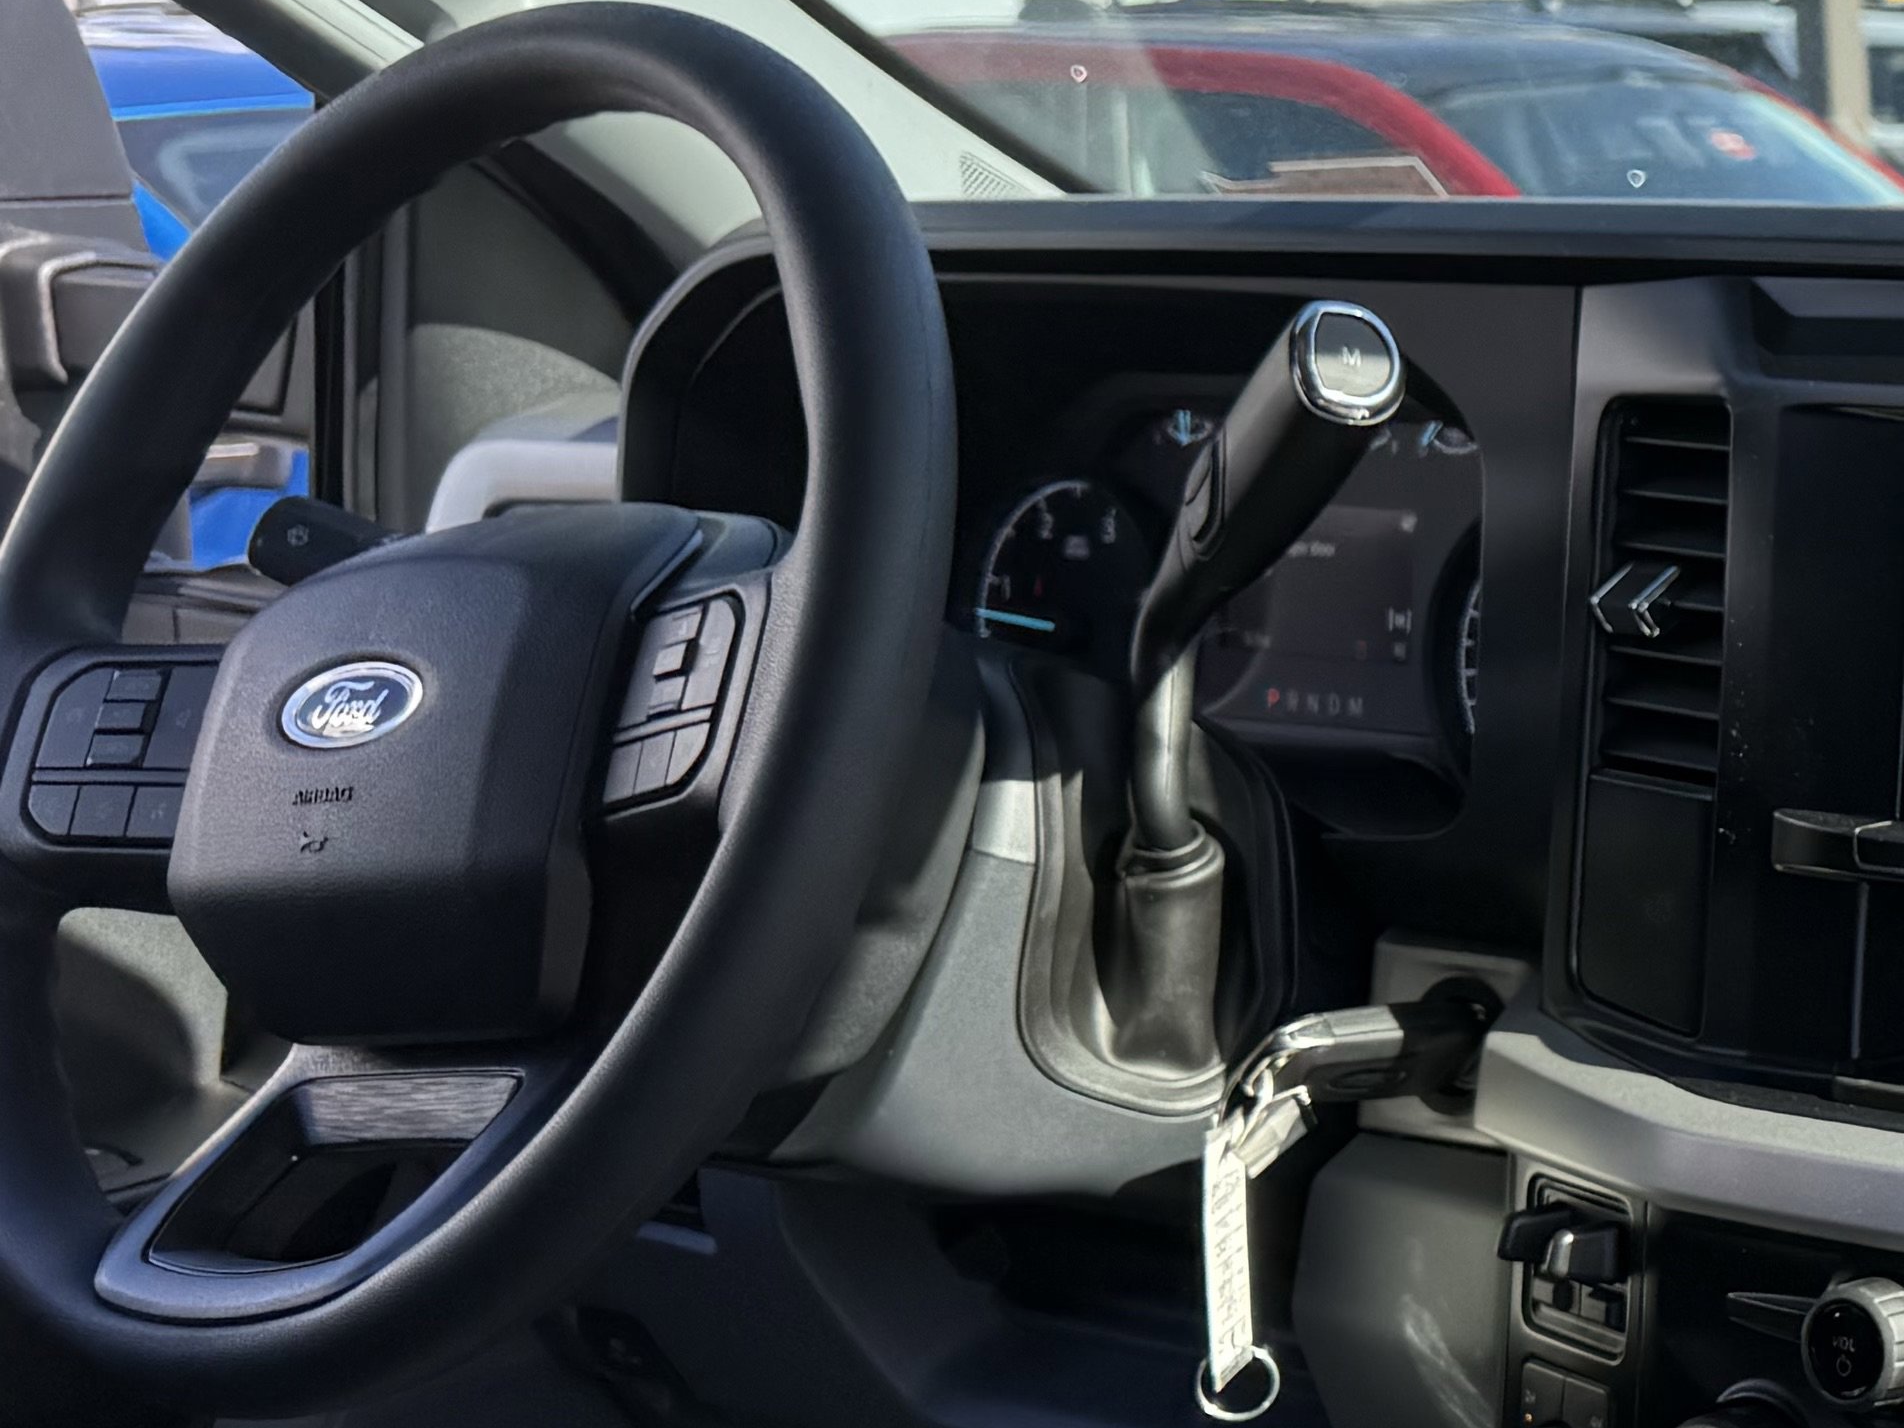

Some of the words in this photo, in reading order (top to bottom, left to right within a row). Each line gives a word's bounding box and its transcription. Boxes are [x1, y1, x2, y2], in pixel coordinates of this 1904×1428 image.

[1342, 346, 1361, 367] M
[311, 680, 389, 730] Ford
[1832, 1335, 1856, 1353] VOL
